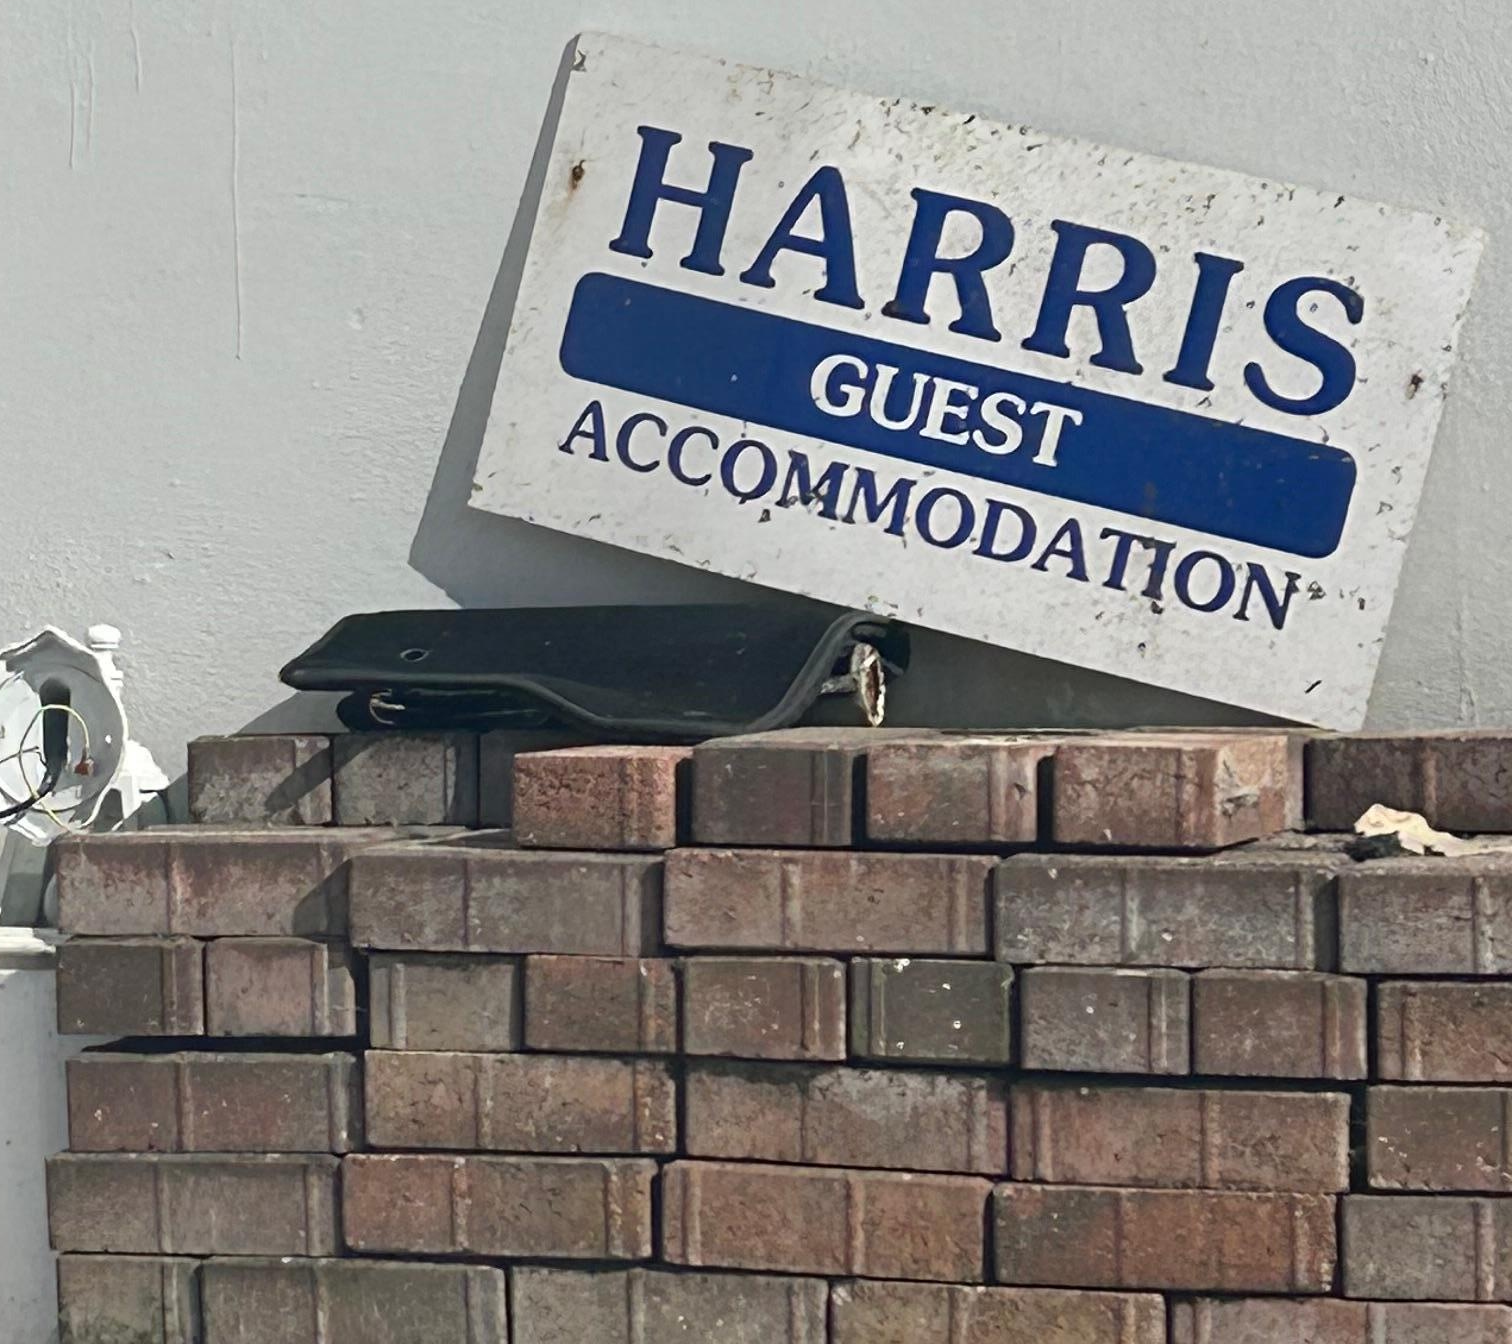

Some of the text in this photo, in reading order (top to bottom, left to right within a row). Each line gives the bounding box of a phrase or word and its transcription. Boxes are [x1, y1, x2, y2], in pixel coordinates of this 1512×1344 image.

[609, 125, 1365, 416] HARRIS
[558, 400, 1300, 630] ACCOMMODATION
[809, 353, 1084, 468] GUEST
